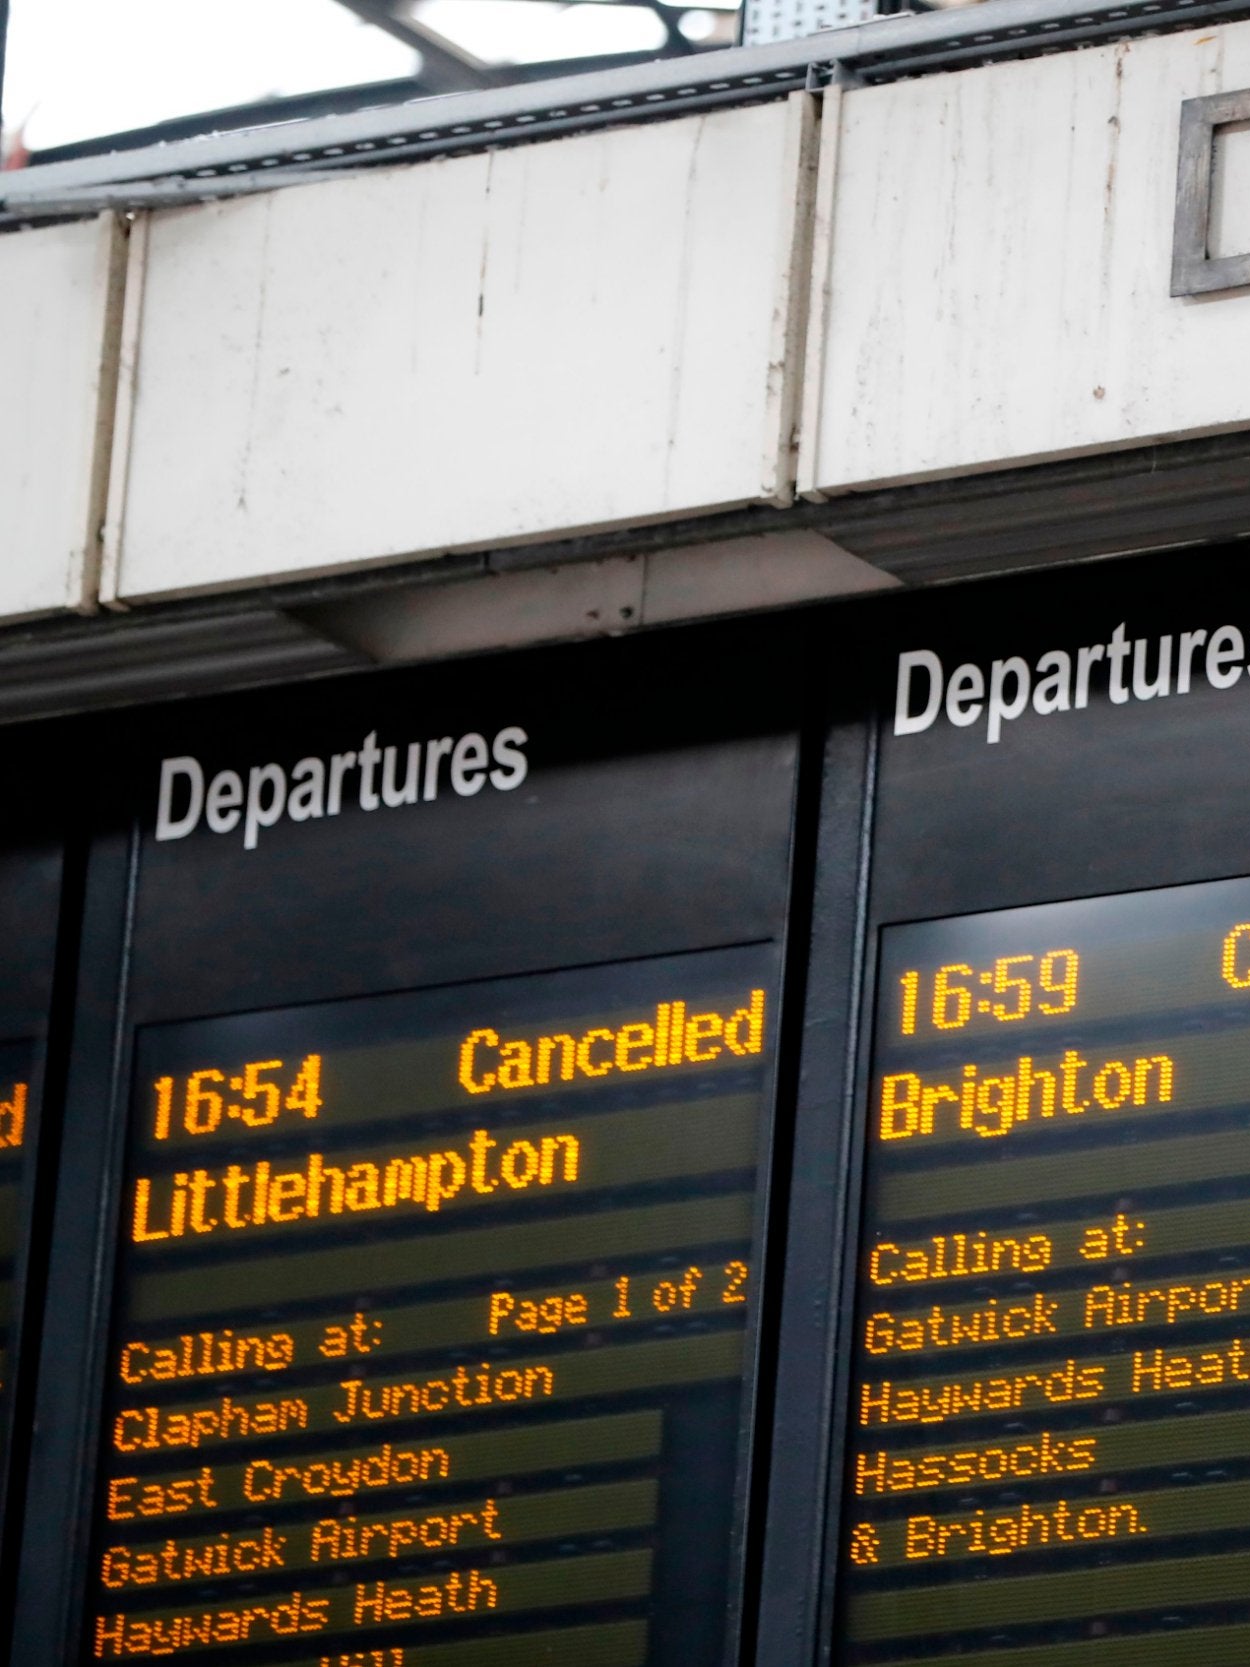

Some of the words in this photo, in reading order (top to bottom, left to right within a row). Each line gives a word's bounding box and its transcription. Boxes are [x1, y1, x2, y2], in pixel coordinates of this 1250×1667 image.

[155, 727, 527, 850] Departures
[899, 949, 1080, 1036] 16:59
[154, 1053, 324, 1140] 16:54
[457, 988, 766, 1095] Cancelled
[879, 1049, 1176, 1141] Brighton
[132, 1129, 581, 1243] Littlehampton
[869, 1231, 1053, 1286] Calling
[1078, 1213, 1145, 1260] at:
[120, 1329, 294, 1384] Calling
[318, 1312, 383, 1358] at:
[488, 1292, 588, 1335] Page
[612, 1276, 632, 1319] 1
[652, 1266, 703, 1313] of
[721, 1260, 748, 1304] 2
[864, 1293, 1059, 1355] Gatwick
[113, 1397, 308, 1452] Clapham
[332, 1362, 554, 1423] Junction
[859, 1359, 1106, 1425] Haywards
[107, 1467, 217, 1521] East
[243, 1444, 449, 1502] Croydon
[855, 1432, 1097, 1495] Hassocks
[101, 1527, 287, 1588] Gatwick
[310, 1499, 502, 1562] Airport
[850, 1522, 881, 1565] &
[905, 1500, 1148, 1559] Brighton.
[95, 1592, 330, 1657] Haywards
[354, 1569, 497, 1625] Heath
